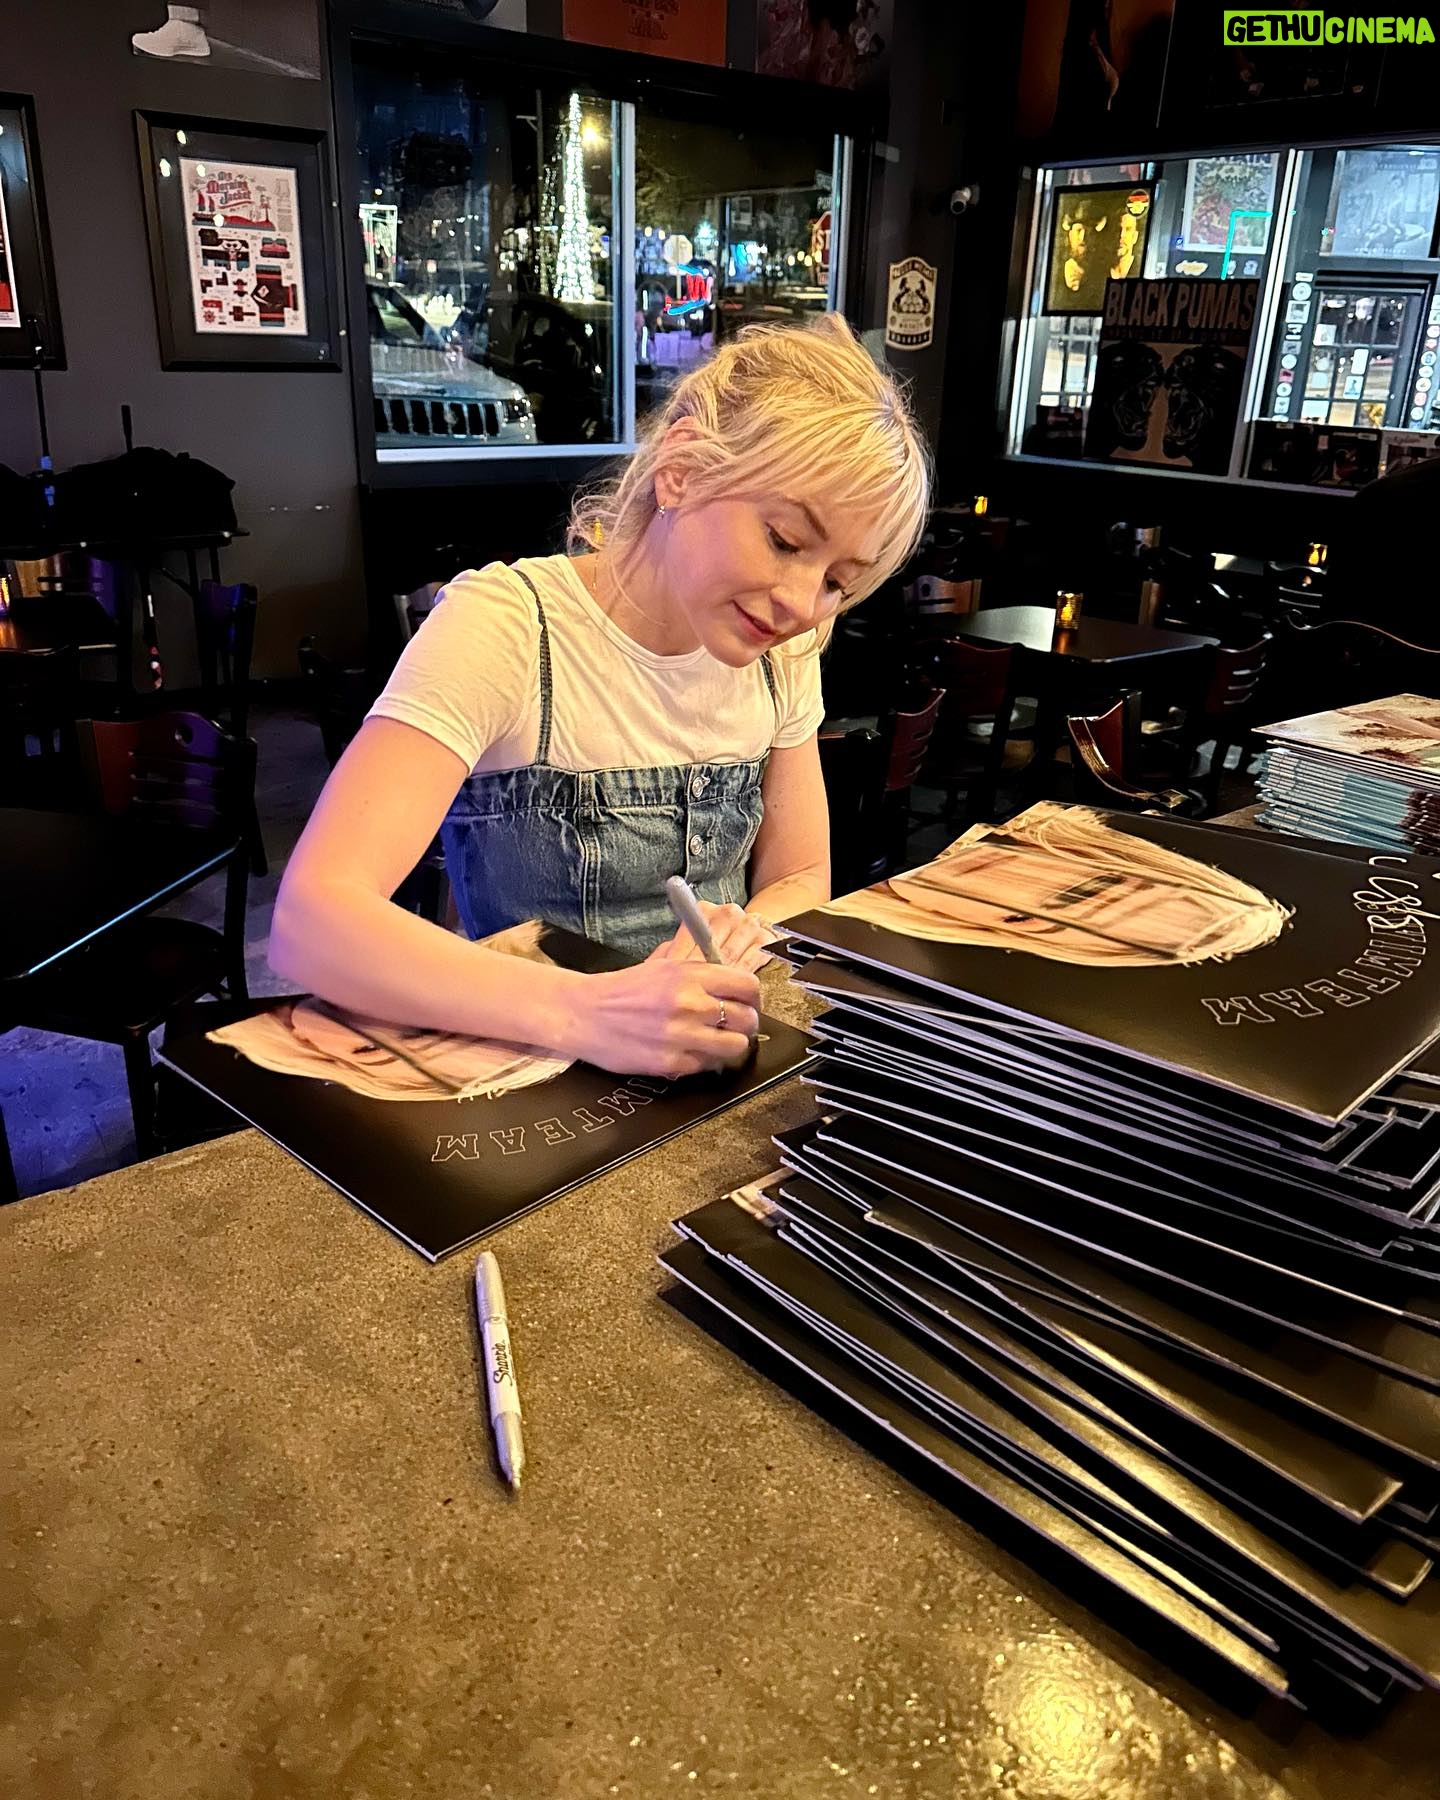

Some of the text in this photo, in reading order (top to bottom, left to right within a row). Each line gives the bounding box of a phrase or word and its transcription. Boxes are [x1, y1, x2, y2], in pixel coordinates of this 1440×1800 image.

[206, 179, 249, 194] Morning
[220, 189, 252, 205] Jacket
[1103, 281, 1258, 329] BLACK PUMAS
[492, 1342, 513, 1386] Sharpie
